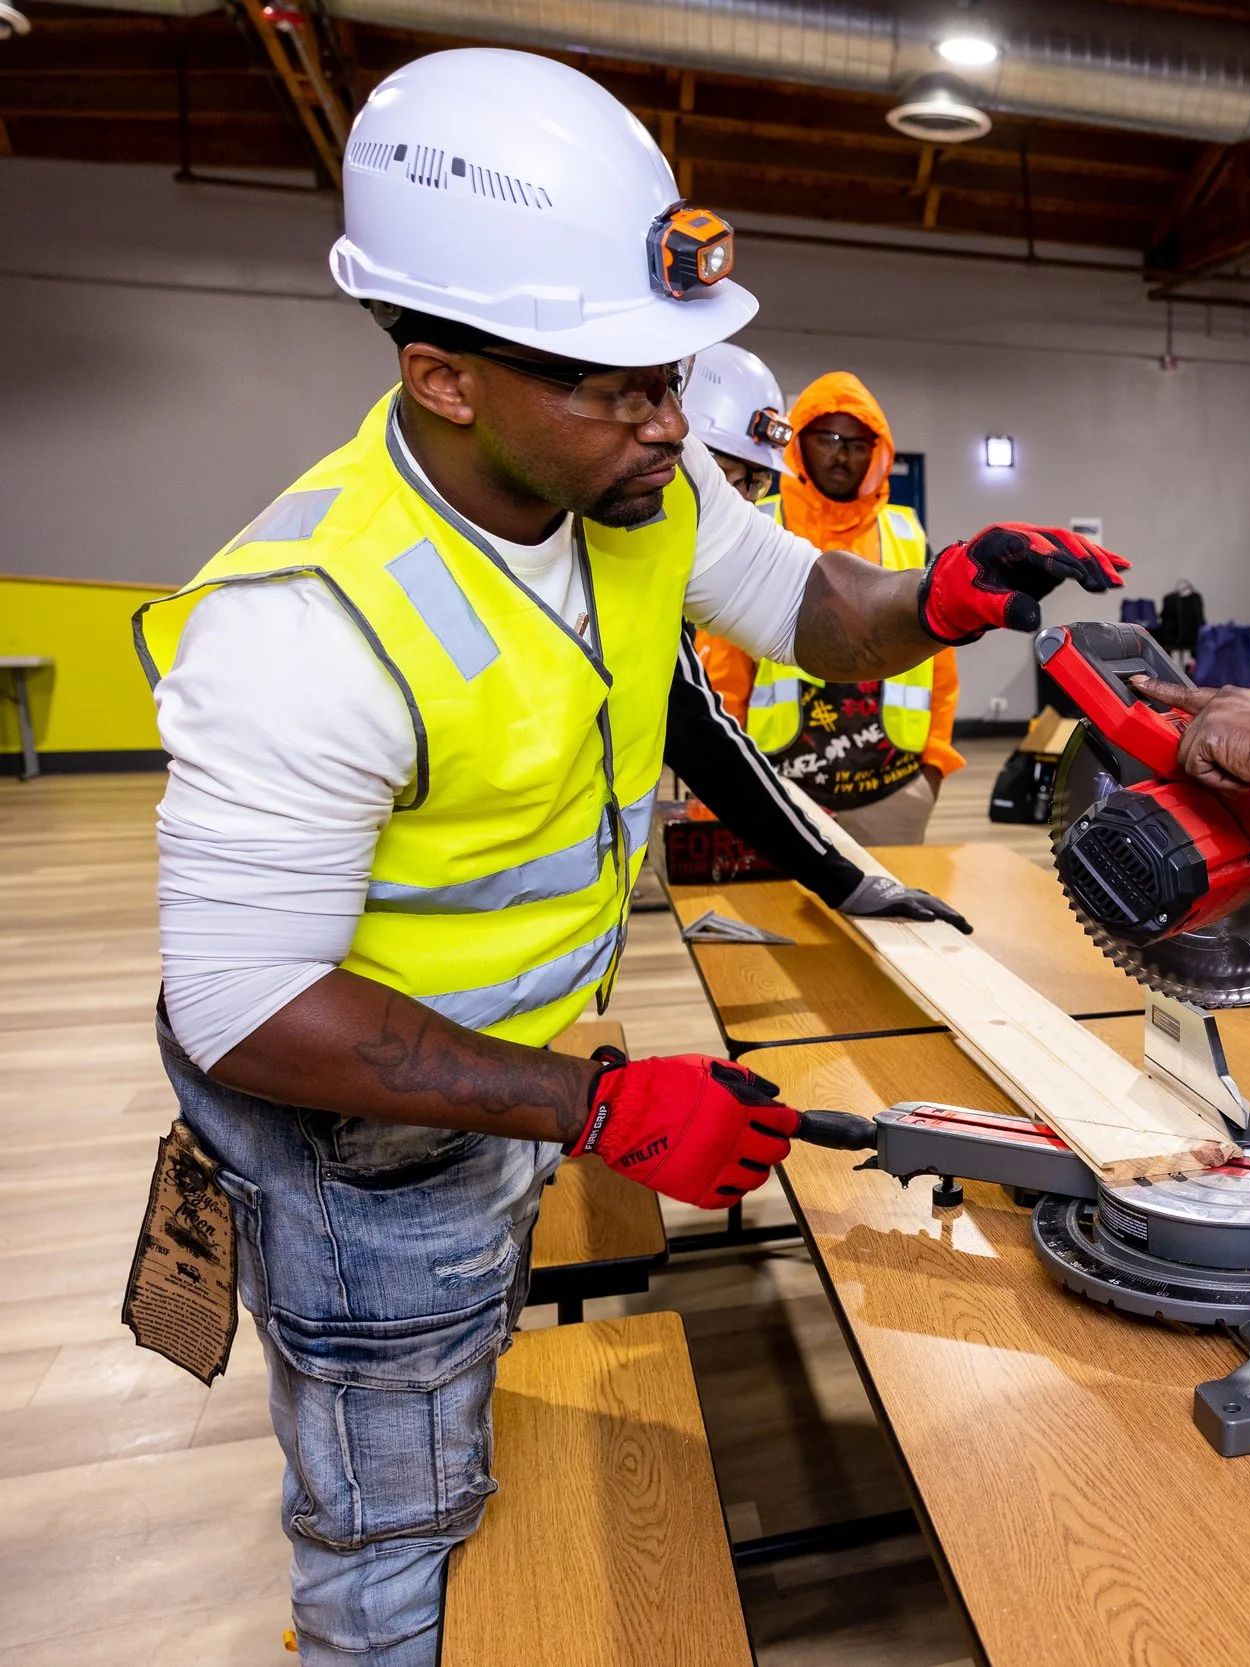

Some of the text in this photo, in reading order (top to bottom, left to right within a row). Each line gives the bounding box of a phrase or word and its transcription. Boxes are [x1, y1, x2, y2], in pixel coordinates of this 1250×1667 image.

[853, 723, 884, 748] ME
[585, 1105, 607, 1150] FIRM GRIP
[620, 1136, 668, 1167] UTILITY
